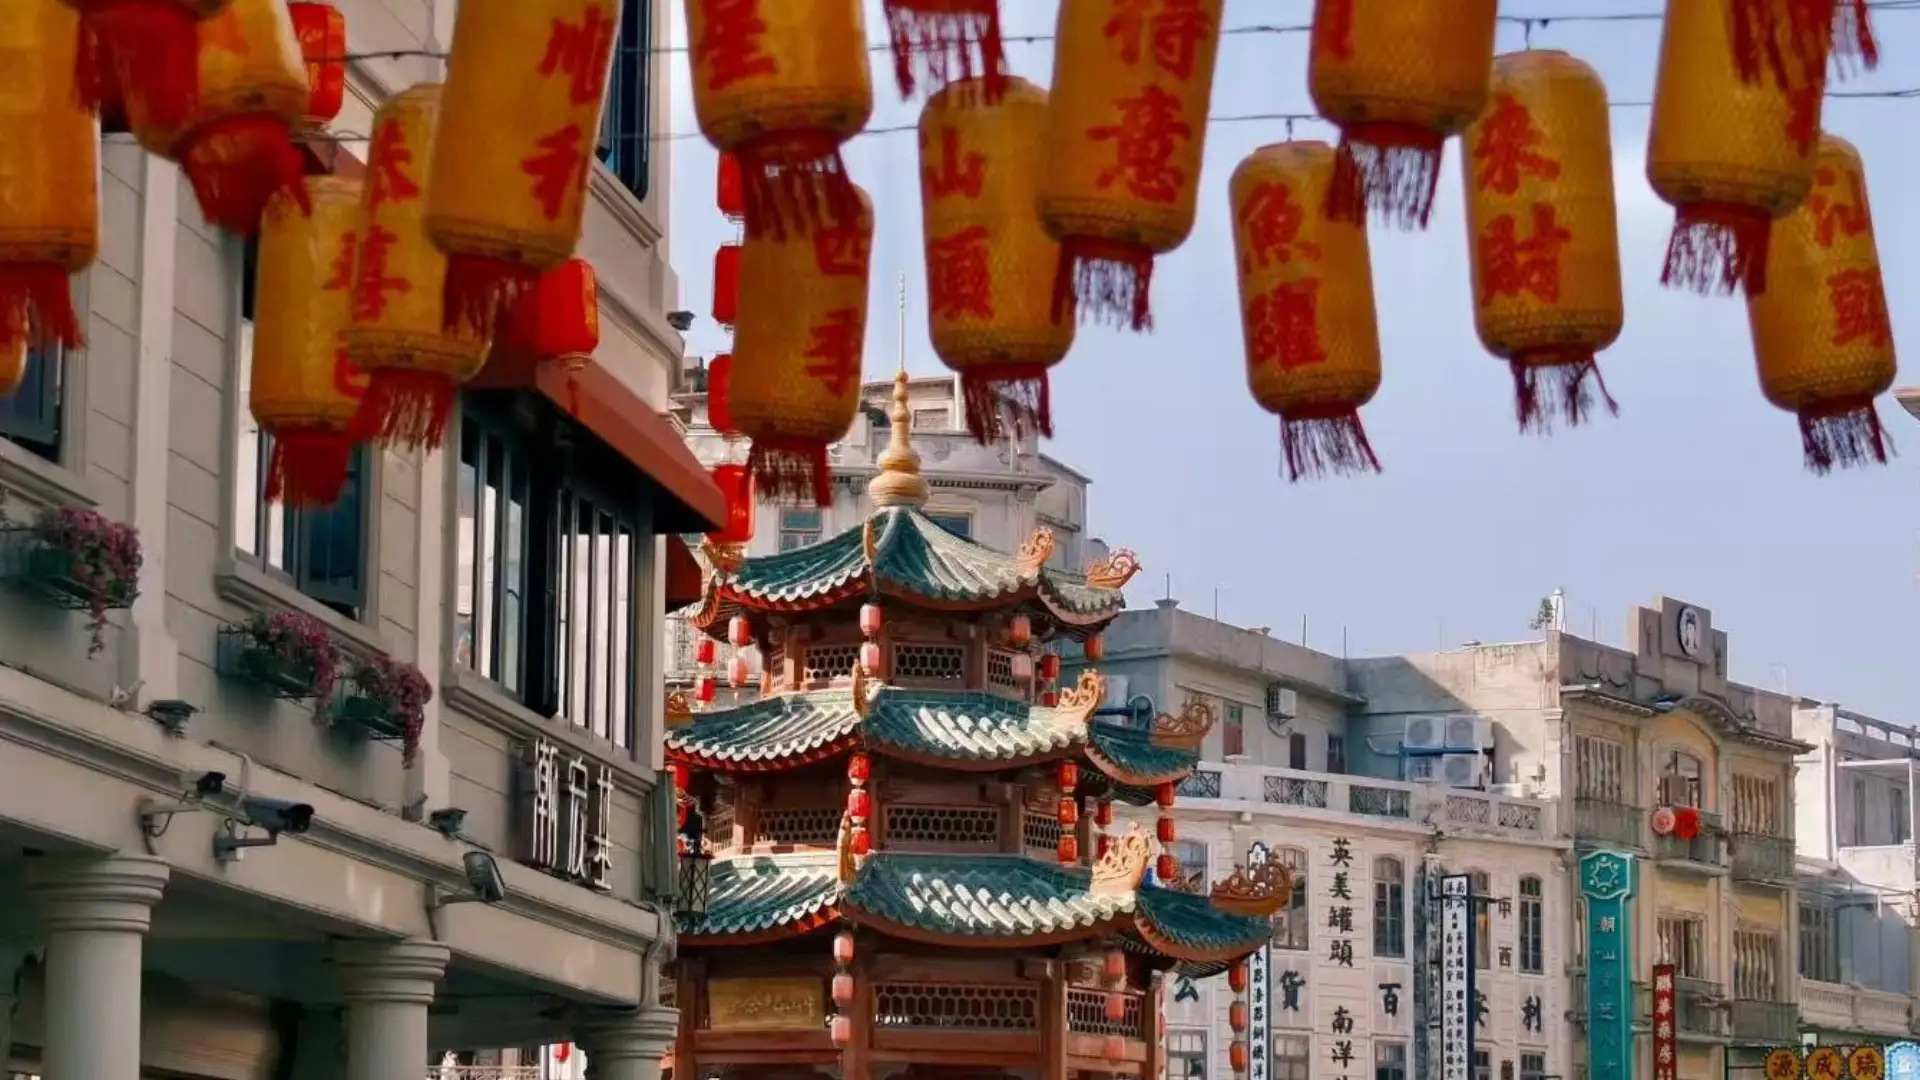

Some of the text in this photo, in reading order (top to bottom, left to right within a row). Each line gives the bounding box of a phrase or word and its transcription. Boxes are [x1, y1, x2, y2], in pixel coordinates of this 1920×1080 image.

[533, 736, 614, 891] 潮宏基
[1328, 837, 1354, 967] 英美罐頭
[1331, 1005, 1354, 1080] 南洋
